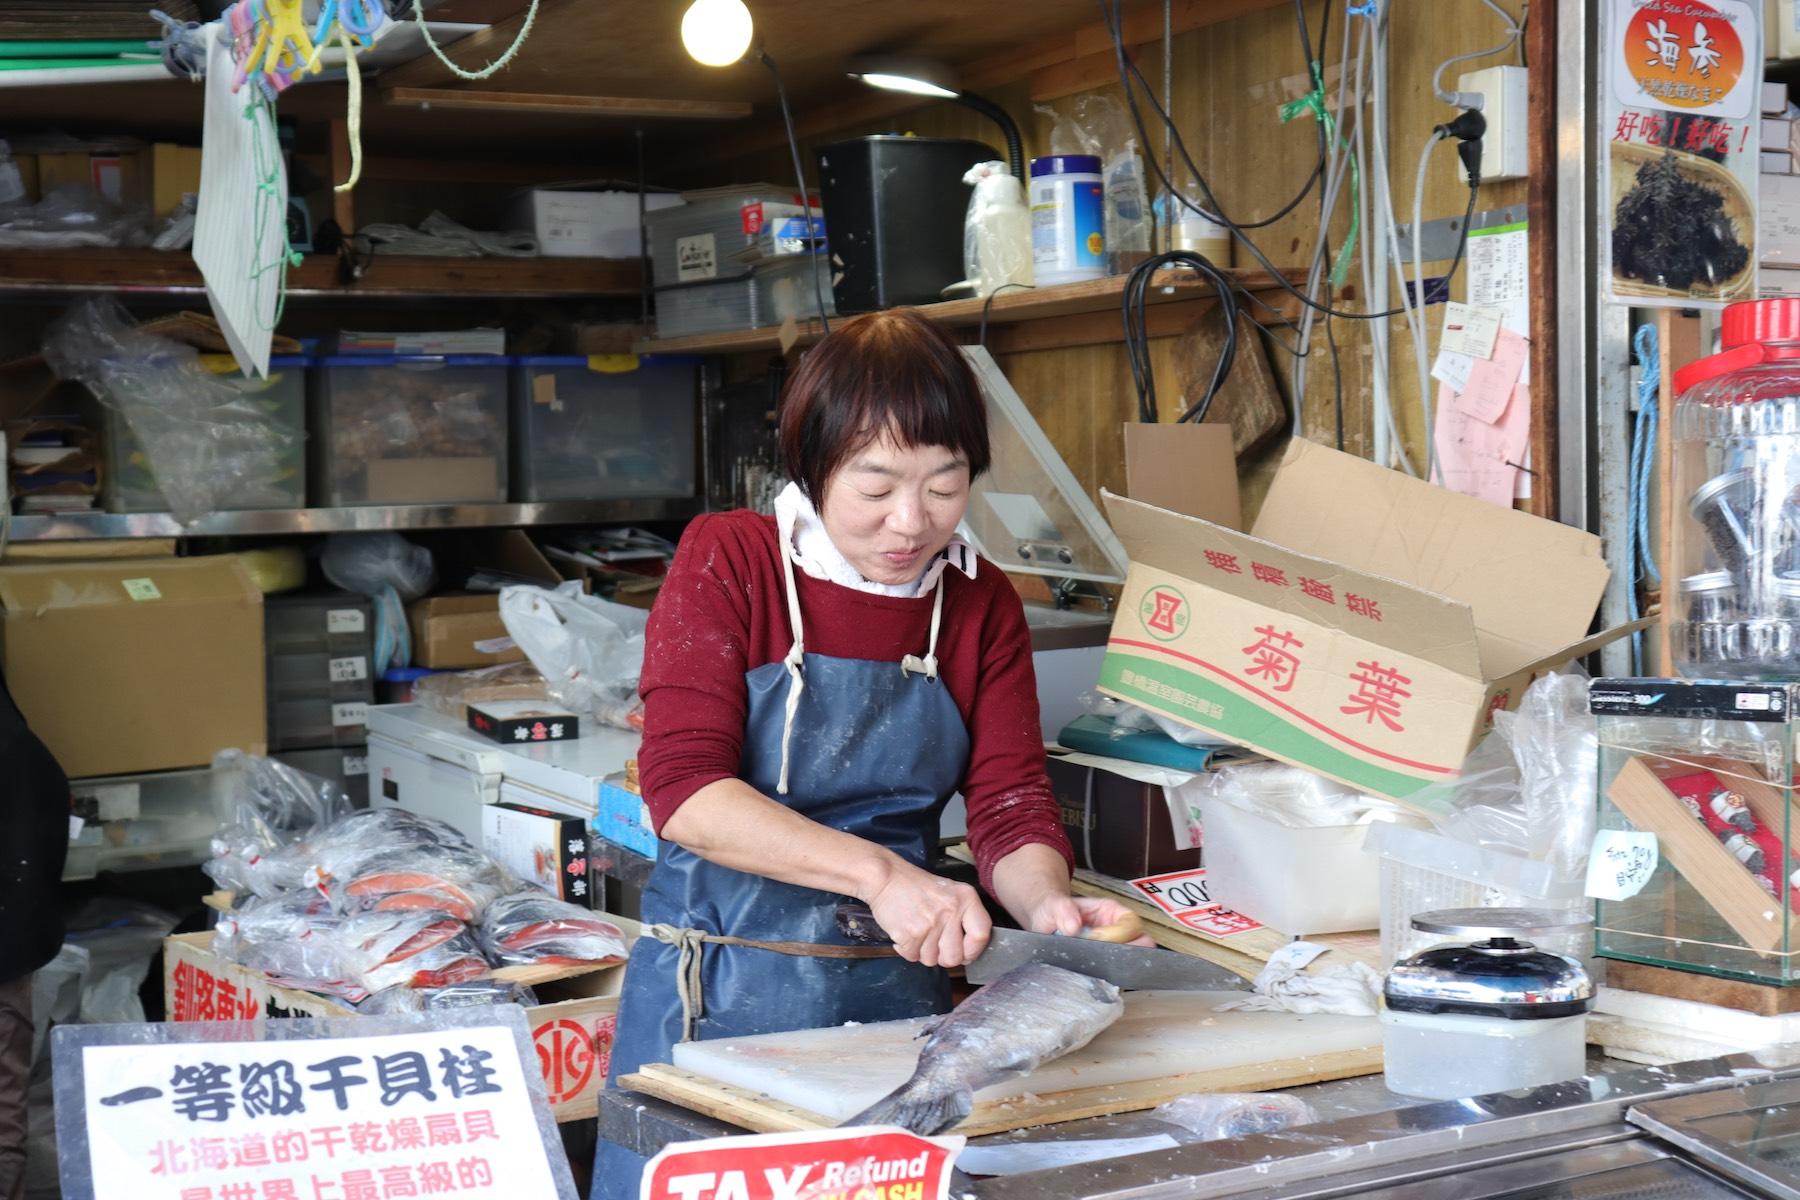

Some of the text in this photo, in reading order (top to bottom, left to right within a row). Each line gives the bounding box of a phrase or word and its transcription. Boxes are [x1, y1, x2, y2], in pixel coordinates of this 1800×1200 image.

[1241, 625, 1412, 733] 菊葉
[99, 1045, 503, 1122] 一等級干貝柱
[150, 1109, 500, 1177] 北海道的干乾燥扇貝
[822, 1150, 930, 1189] Refund
